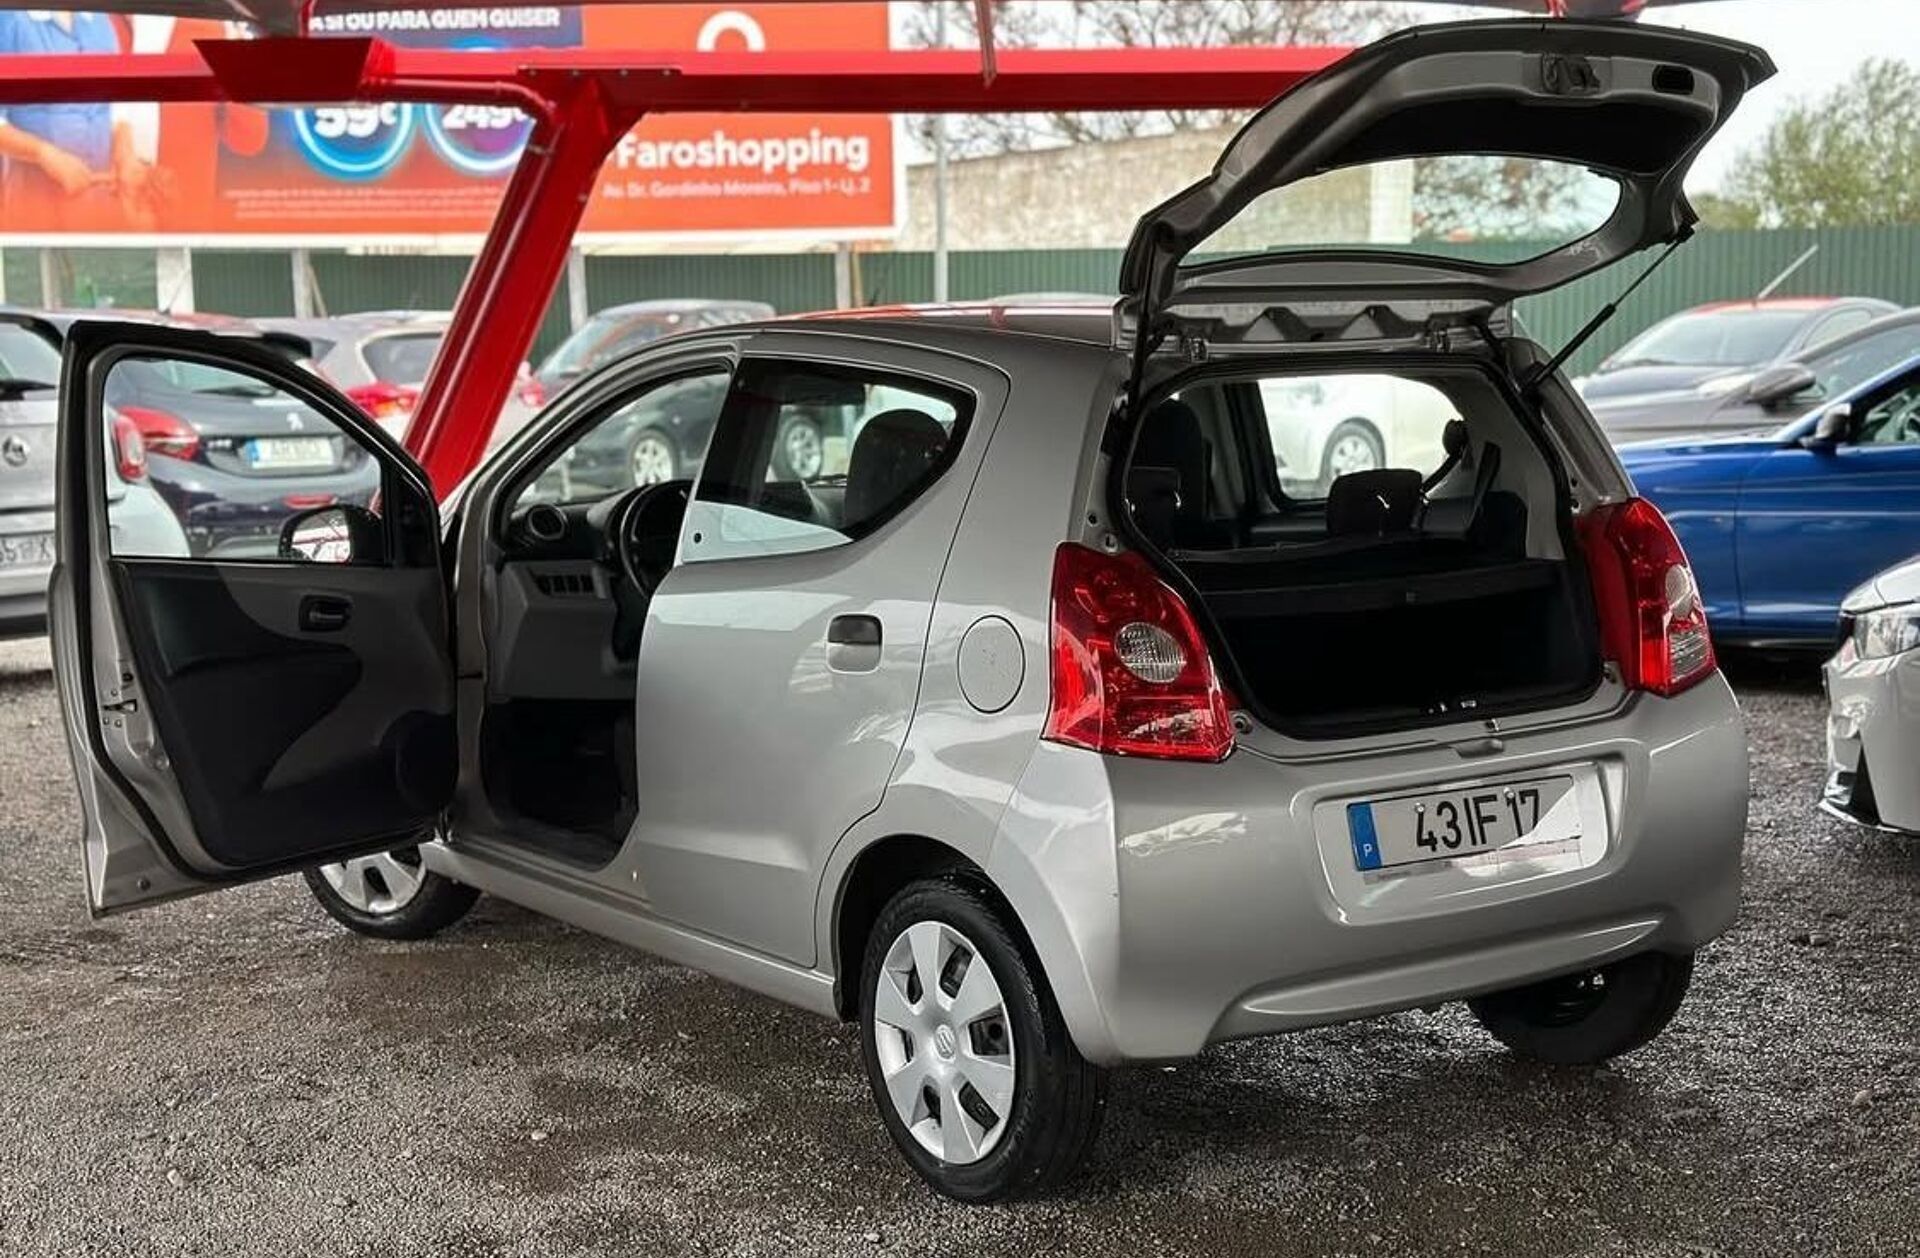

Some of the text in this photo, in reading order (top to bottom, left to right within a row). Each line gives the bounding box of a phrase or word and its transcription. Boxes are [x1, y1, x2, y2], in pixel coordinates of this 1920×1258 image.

[347, 13, 374, 30] OU
[377, 10, 430, 29] PARA
[431, 9, 488, 29] QUEM
[489, 7, 560, 28] QUISER
[616, 128, 869, 174] Faroshopping
